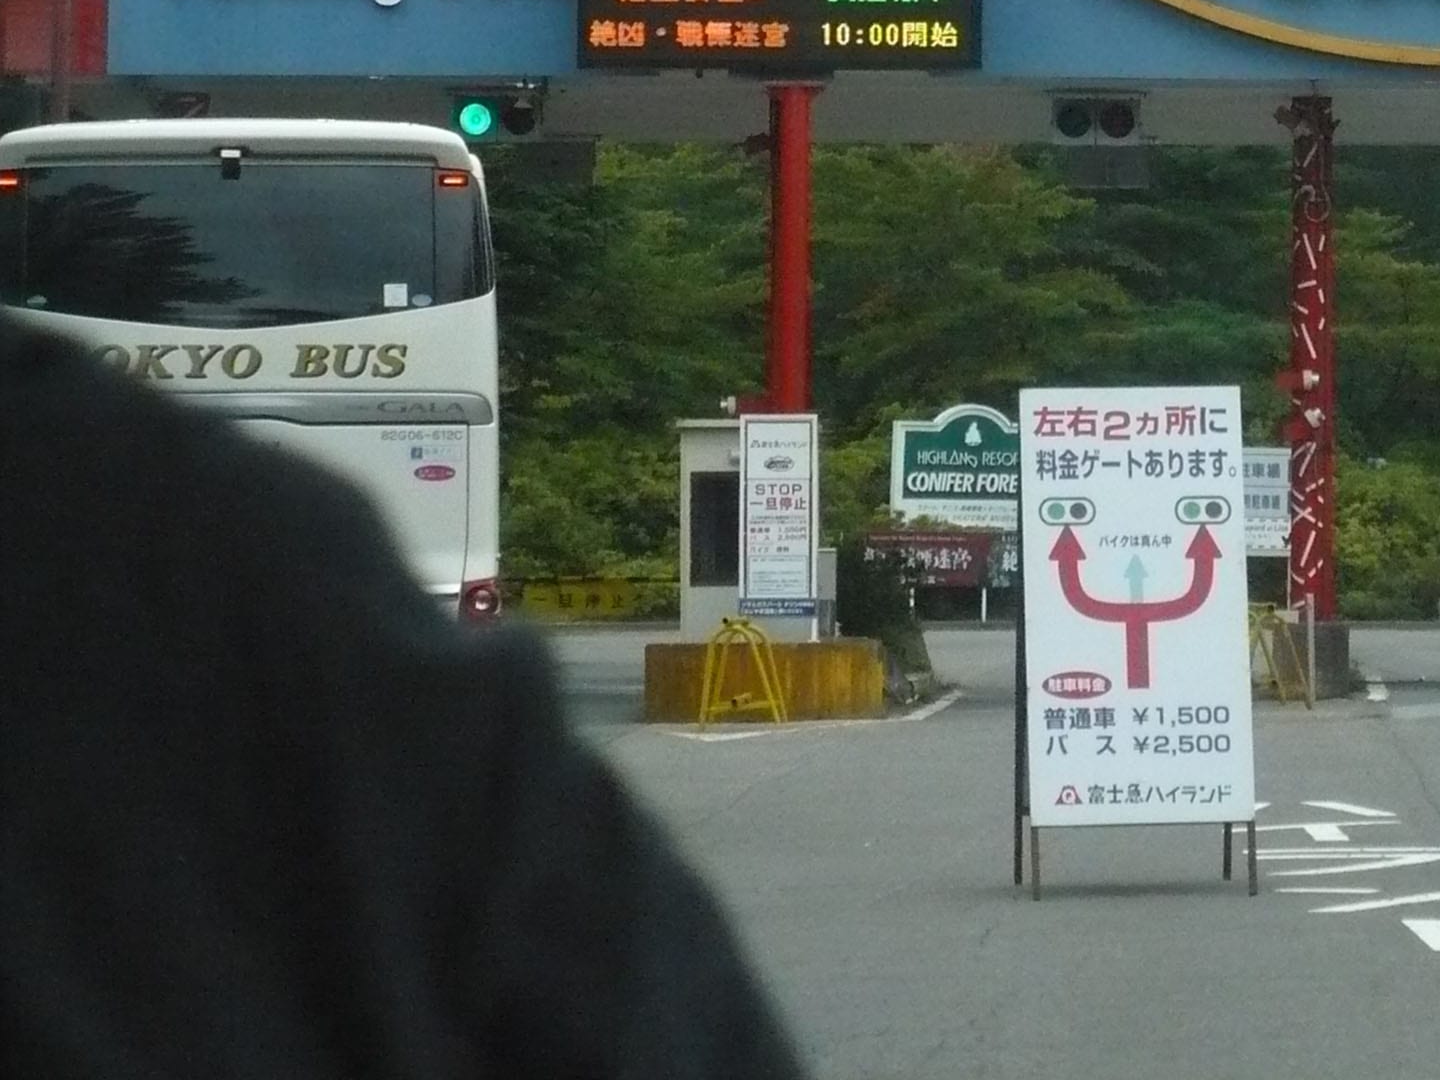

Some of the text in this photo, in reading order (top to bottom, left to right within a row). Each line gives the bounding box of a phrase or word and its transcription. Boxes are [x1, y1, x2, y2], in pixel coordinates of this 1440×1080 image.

[820, 20, 959, 48] 10:00開始
[98, 342, 409, 380] OKYO BUS
[377, 399, 465, 413] GALA
[1036, 449, 1237, 480] 料金ゲートあります。
[754, 483, 803, 496] STOP
[906, 471, 973, 493] CONIFER
[749, 496, 807, 511] 一旦停止
[1099, 534, 1173, 548] バイクは真ん中
[1048, 677, 1107, 693] 駐車料金
[1043, 707, 1116, 730] 普通車
[1087, 782, 1233, 805] 富士急ハイランド
